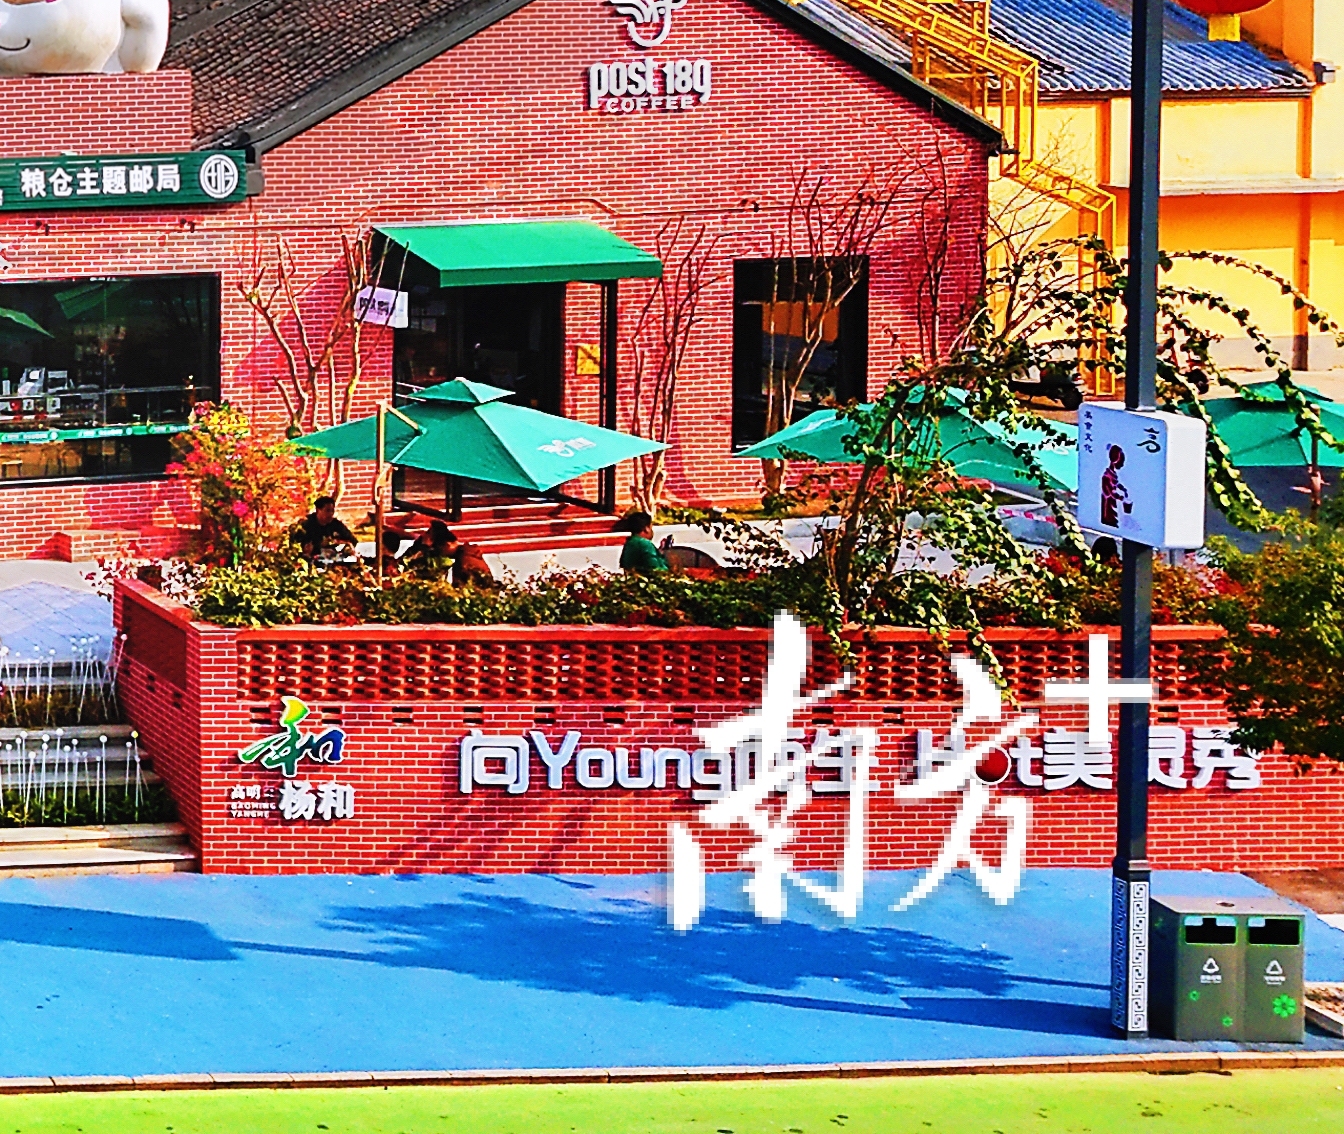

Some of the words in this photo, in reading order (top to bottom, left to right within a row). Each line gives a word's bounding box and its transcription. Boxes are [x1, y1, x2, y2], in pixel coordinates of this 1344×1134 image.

[606, 96, 694, 113] COFFEE
[21, 164, 181, 198] 粮仓主题邮局
[231, 783, 261, 800] 高明
[278, 779, 356, 821] 杨和
